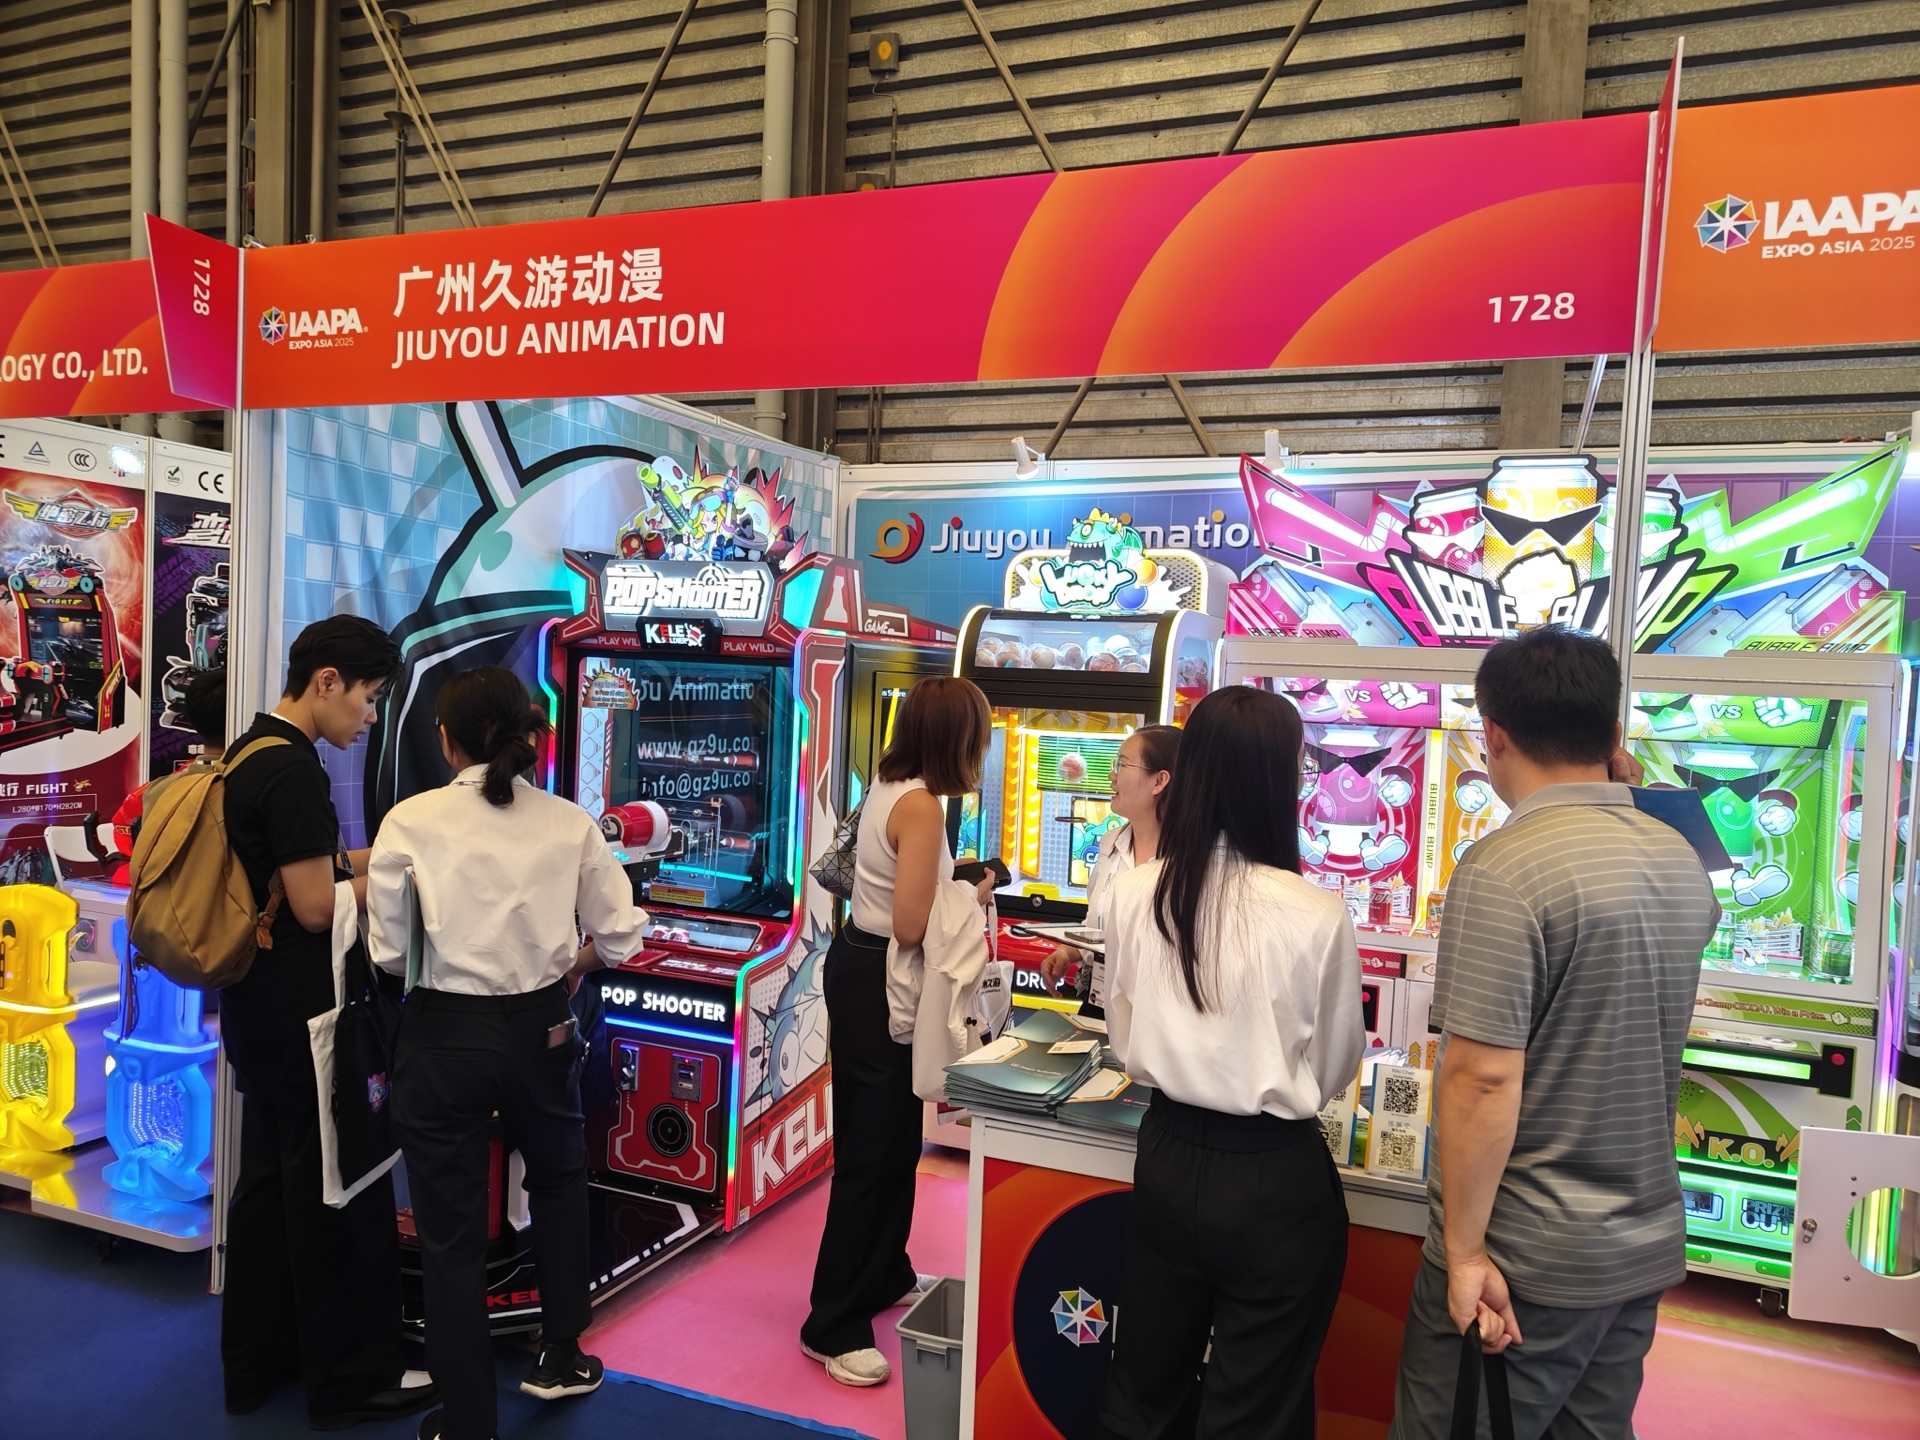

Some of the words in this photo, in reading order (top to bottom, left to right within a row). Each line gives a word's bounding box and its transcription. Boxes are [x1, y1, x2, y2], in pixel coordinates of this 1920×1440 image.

[1763, 188, 1920, 239] IAAPA
[1761, 243, 1815, 259] EXPO
[1819, 239, 1864, 255] ASIA
[1869, 235, 1915, 252] 2025
[193, 257, 211, 316] 1728
[392, 247, 664, 318] 广州久游动漫
[288, 307, 364, 338] IAAPA
[1487, 292, 1576, 323] 1728
[288, 340, 312, 350] EXPO
[313, 337, 333, 348] ASIA
[334, 337, 355, 347] 2025
[391, 325, 508, 369] JIUYOU
[517, 311, 725, 355] ANIMATION
[0, 353, 47, 383] OGY
[52, 351, 95, 383] CO.,
[102, 347, 148, 376] LTD.
[930, 516, 1051, 559] Jiuyou
[603, 575, 659, 608] POP
[653, 577, 763, 611] SHOOTER
[1041, 560, 1134, 595] LUCKY
[1364, 552, 1519, 648] BUBBLE
[598, 636, 620, 646] PLAY
[644, 622, 685, 644] KELE
[864, 618, 891, 635] GAME
[1302, 628, 1342, 638] BUMP
[723, 641, 748, 652] PLAY
[748, 643, 775, 653] WILD
[1345, 687, 1372, 703] VS
[1710, 704, 1743, 719] VS
[25, 782, 69, 796] FIGHT
[1427, 783, 1438, 830] BUBBLE
[1425, 836, 1435, 869] BUMP
[601, 985, 637, 1007] POP
[641, 991, 727, 1022] SHOOTER
[1707, 1136, 1775, 1168] K.O.
[1740, 1210, 1794, 1236] OUT
